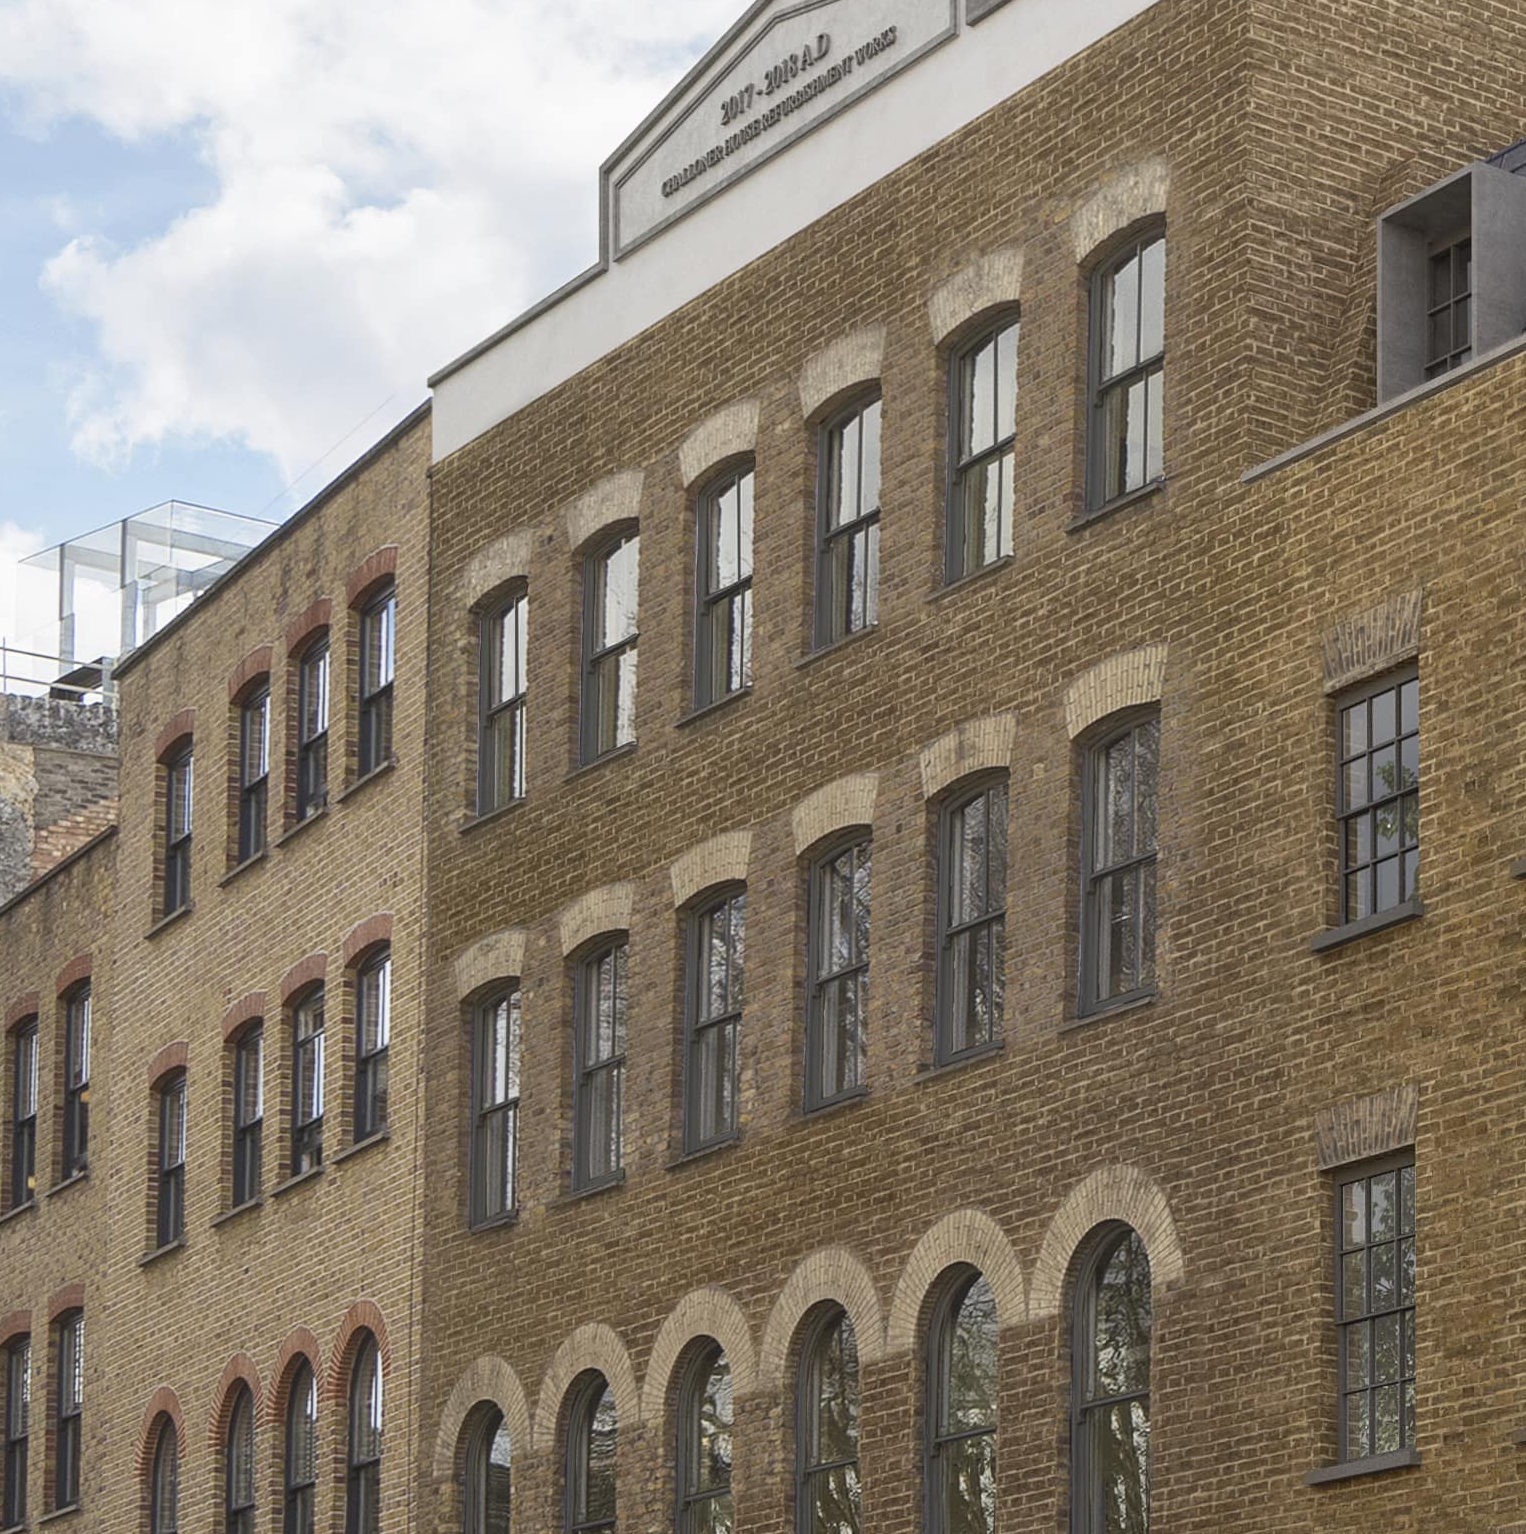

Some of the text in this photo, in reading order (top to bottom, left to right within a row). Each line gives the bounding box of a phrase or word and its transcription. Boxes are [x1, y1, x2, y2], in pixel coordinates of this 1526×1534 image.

[661, 25, 897, 198] CHALLONER HOUSE REFURBISHMENT WORKS
[720, 83, 755, 126] 2017
[764, 53, 799, 95] 2018
